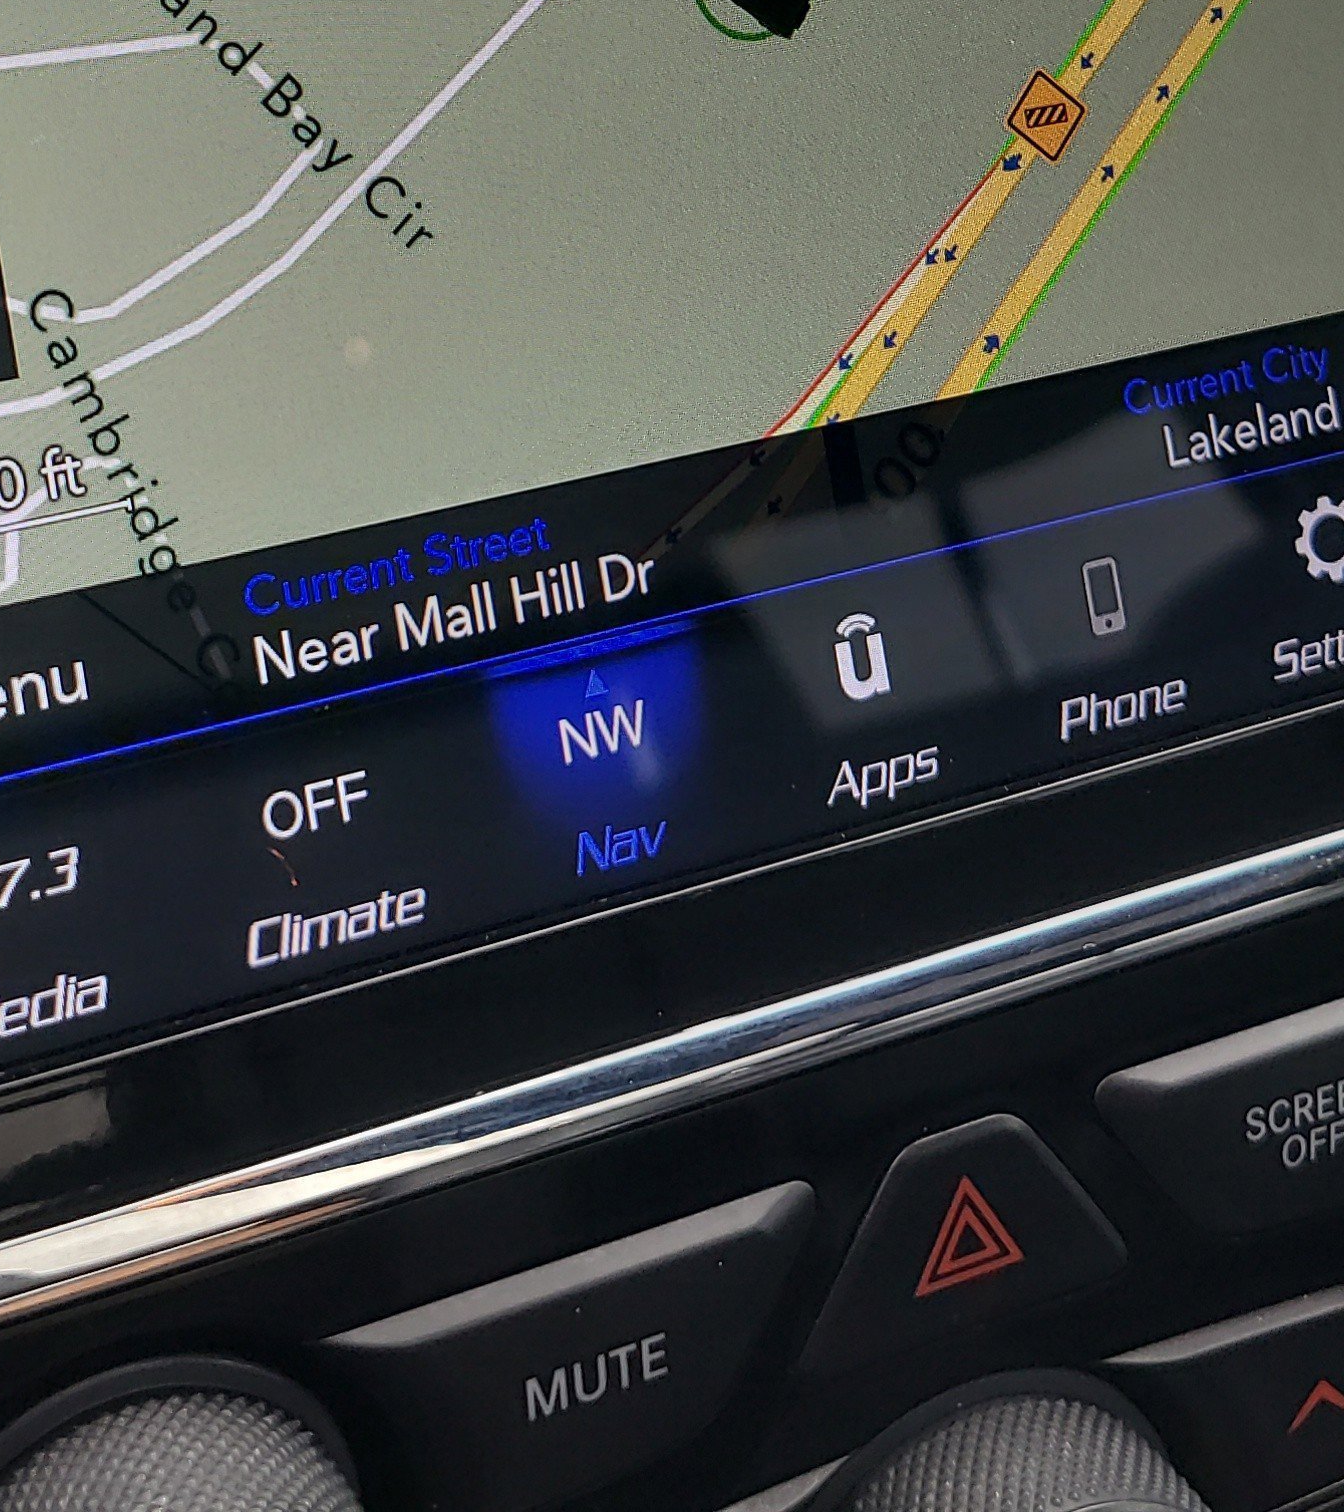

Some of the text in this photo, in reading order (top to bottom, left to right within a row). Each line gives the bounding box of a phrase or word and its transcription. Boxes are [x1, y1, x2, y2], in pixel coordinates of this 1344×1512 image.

[261, 74, 353, 173] Bay
[365, 176, 434, 250] Cir
[1123, 344, 1329, 415] Current City
[1162, 385, 1343, 469] Lakeland
[40, 445, 87, 501] ft
[243, 517, 552, 616] Current Street
[253, 552, 655, 685] Near Mall Hill Dr
[557, 698, 646, 766] NW
[1060, 678, 1189, 744] Phone
[262, 769, 370, 841] OFF
[827, 745, 940, 810] Apps
[576, 818, 668, 878] Nav
[246, 886, 427, 971] Climate
[523, 1331, 670, 1424] MUTE
